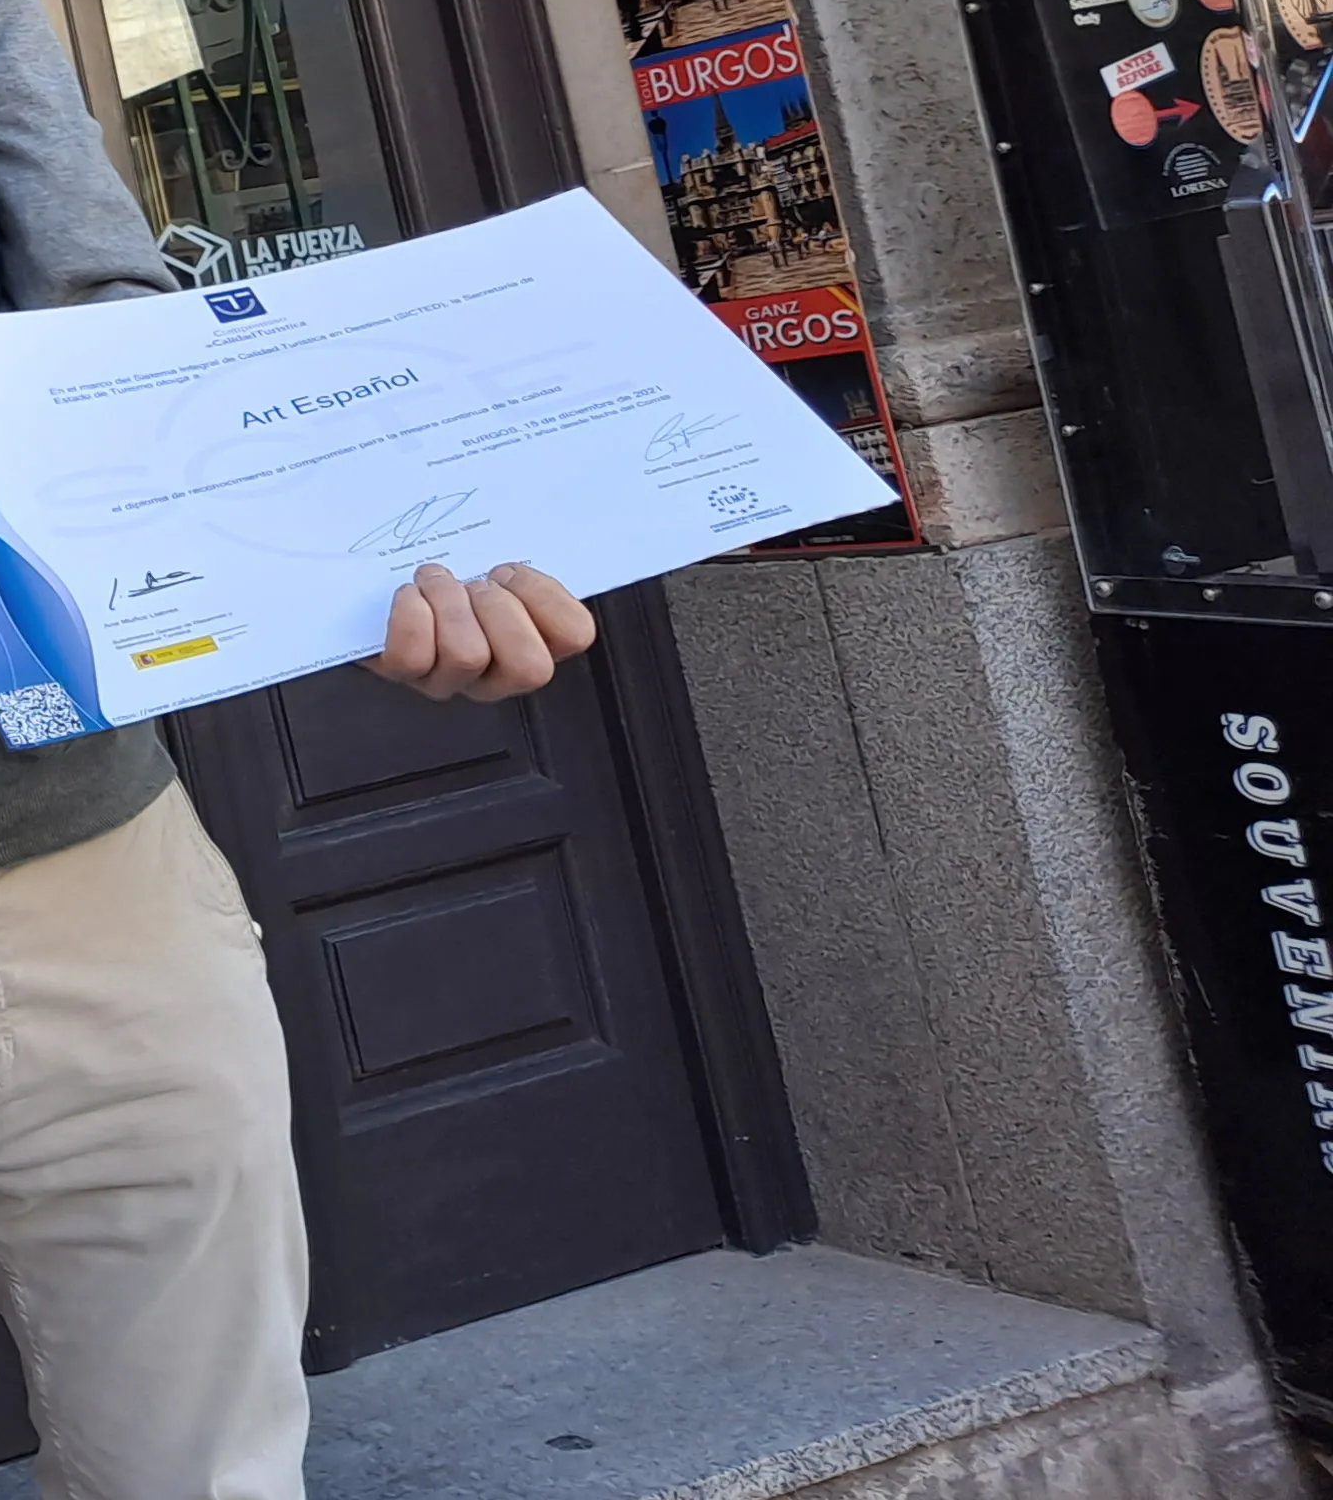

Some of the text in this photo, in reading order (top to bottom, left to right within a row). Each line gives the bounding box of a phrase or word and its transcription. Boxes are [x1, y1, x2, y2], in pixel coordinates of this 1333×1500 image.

[648, 34, 797, 104] BURGOS
[1117, 50, 1156, 74] ANTES
[1170, 177, 1229, 199] LORENA
[240, 236, 274, 264] LA
[275, 224, 365, 260] FUERZA
[745, 301, 801, 320] GANZ
[222, 355, 236, 364] de
[242, 367, 420, 429] Art Español
[171, 491, 185, 500] de
[188, 468, 273, 495] reconocimiento
